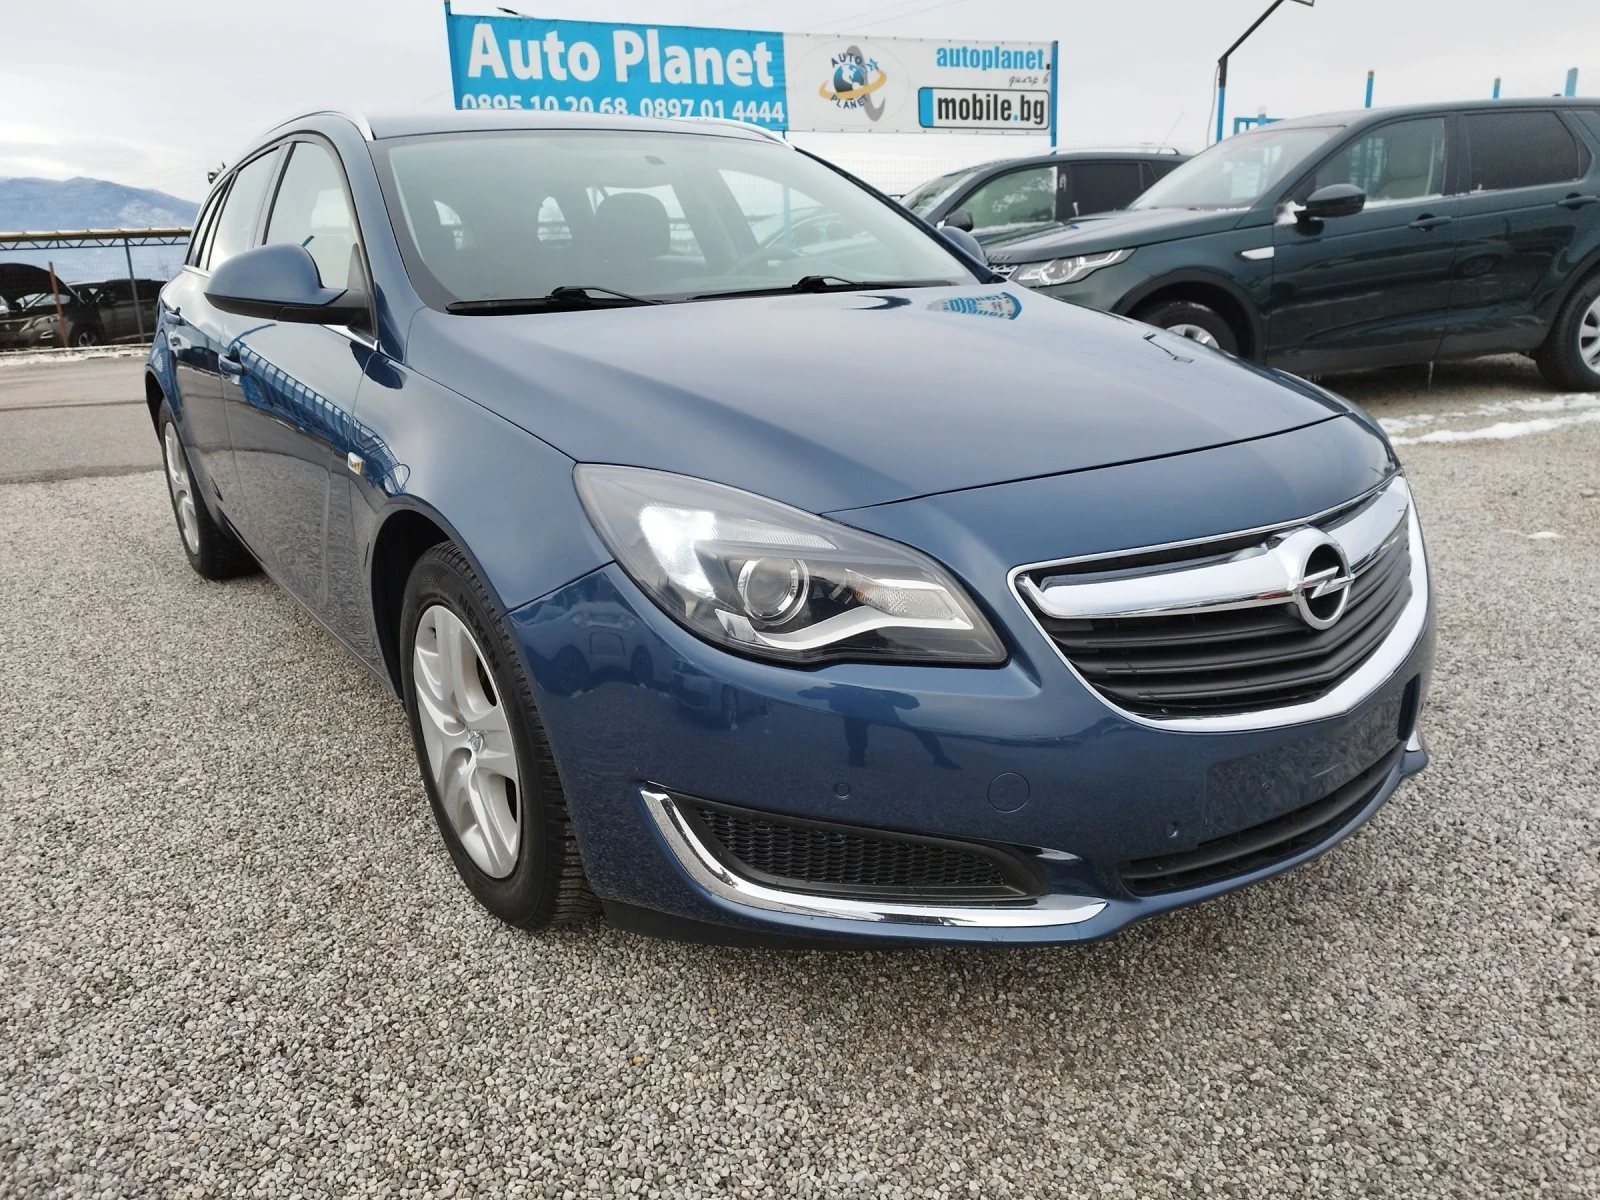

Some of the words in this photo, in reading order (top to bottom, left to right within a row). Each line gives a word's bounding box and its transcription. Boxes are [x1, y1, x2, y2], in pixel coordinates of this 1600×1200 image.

[467, 23, 601, 82] Auto
[612, 28, 774, 88] Planet
[831, 53, 863, 68] AUTO
[461, 93, 524, 109] 0895
[530, 95, 560, 111] 10
[565, 95, 594, 113] 20
[599, 96, 635, 116] 68
[639, 97, 695, 119] 0897
[700, 99, 725, 119] 01
[732, 100, 785, 123] 4444
[830, 93, 868, 109] PLANET
[937, 93, 1045, 125] mobile.bg
[458, 592, 500, 672] NEXEN
